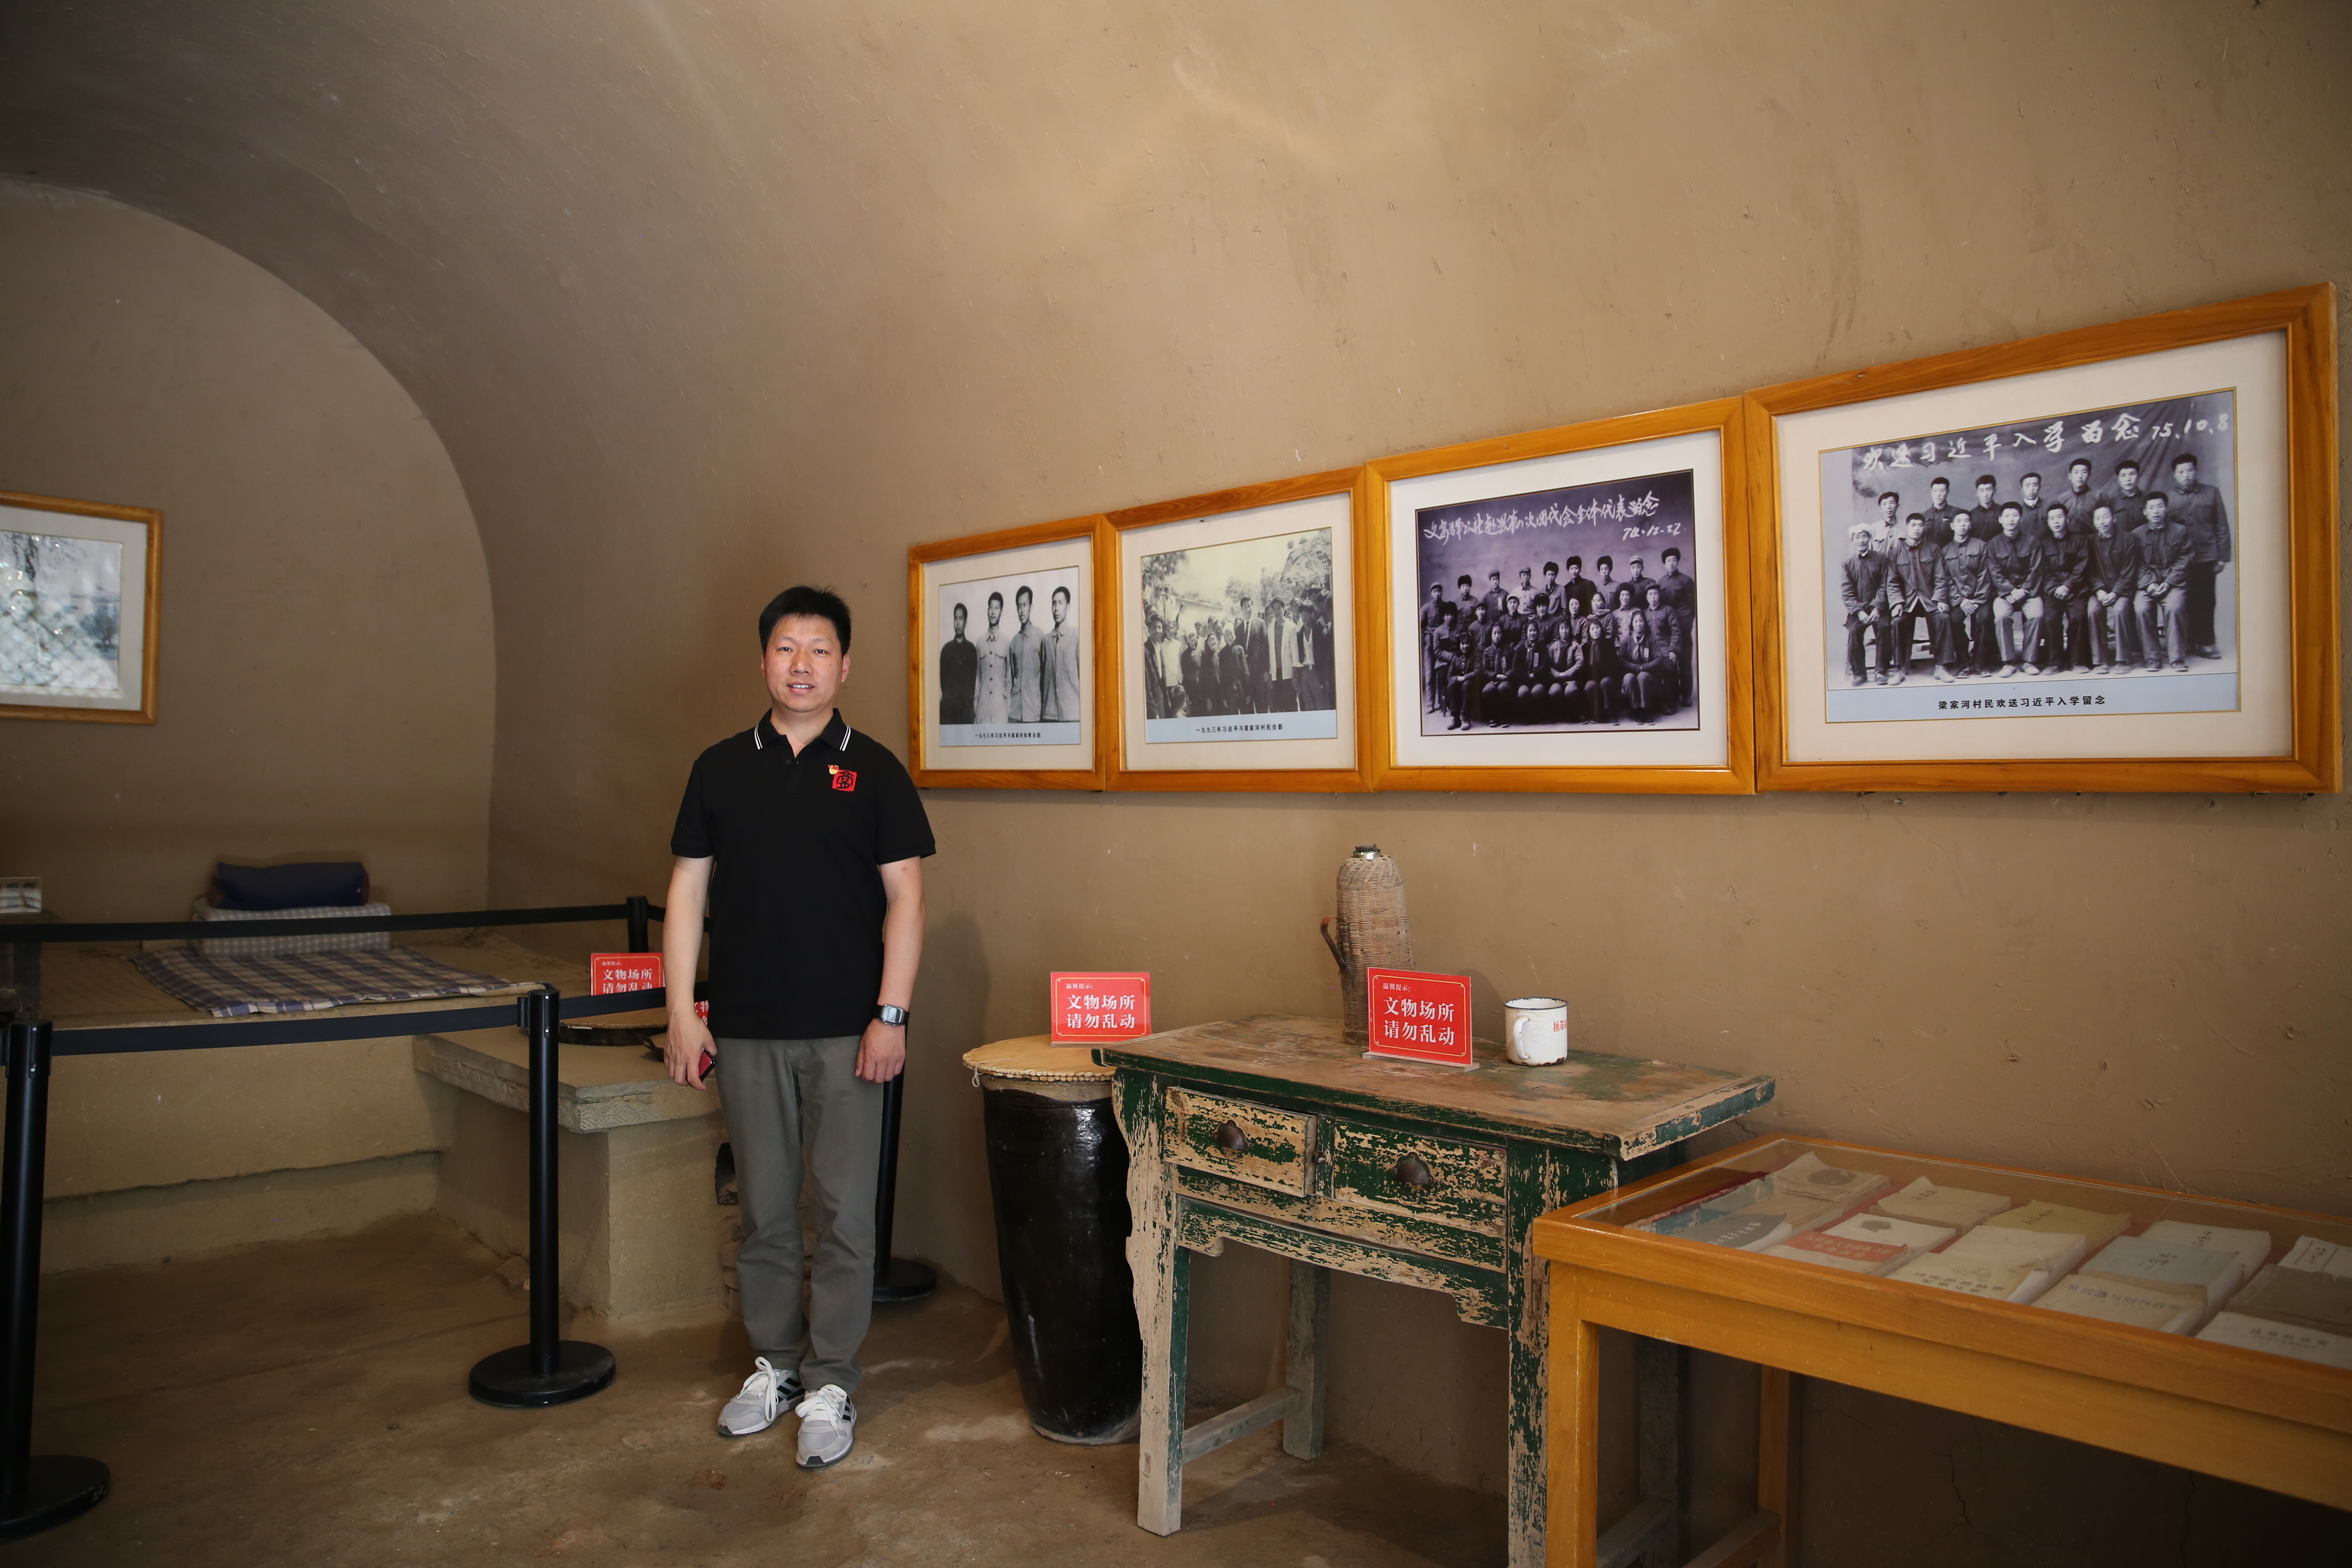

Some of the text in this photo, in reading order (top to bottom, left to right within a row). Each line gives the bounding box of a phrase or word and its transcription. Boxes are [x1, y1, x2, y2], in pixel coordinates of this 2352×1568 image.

[1938, 695, 2106, 710] 梁家河村民欢送习近平入学留念
[1196, 723, 1283, 733] 一九九三年习近平与梁家河村民合影
[602, 968, 653, 980] 文物场所
[1066, 994, 1136, 1010] 文物场所
[1383, 996, 1455, 1022] 文物场所
[1066, 1013, 1136, 1029] 请勿乱动
[1383, 1019, 1455, 1046] 请勿乱动
